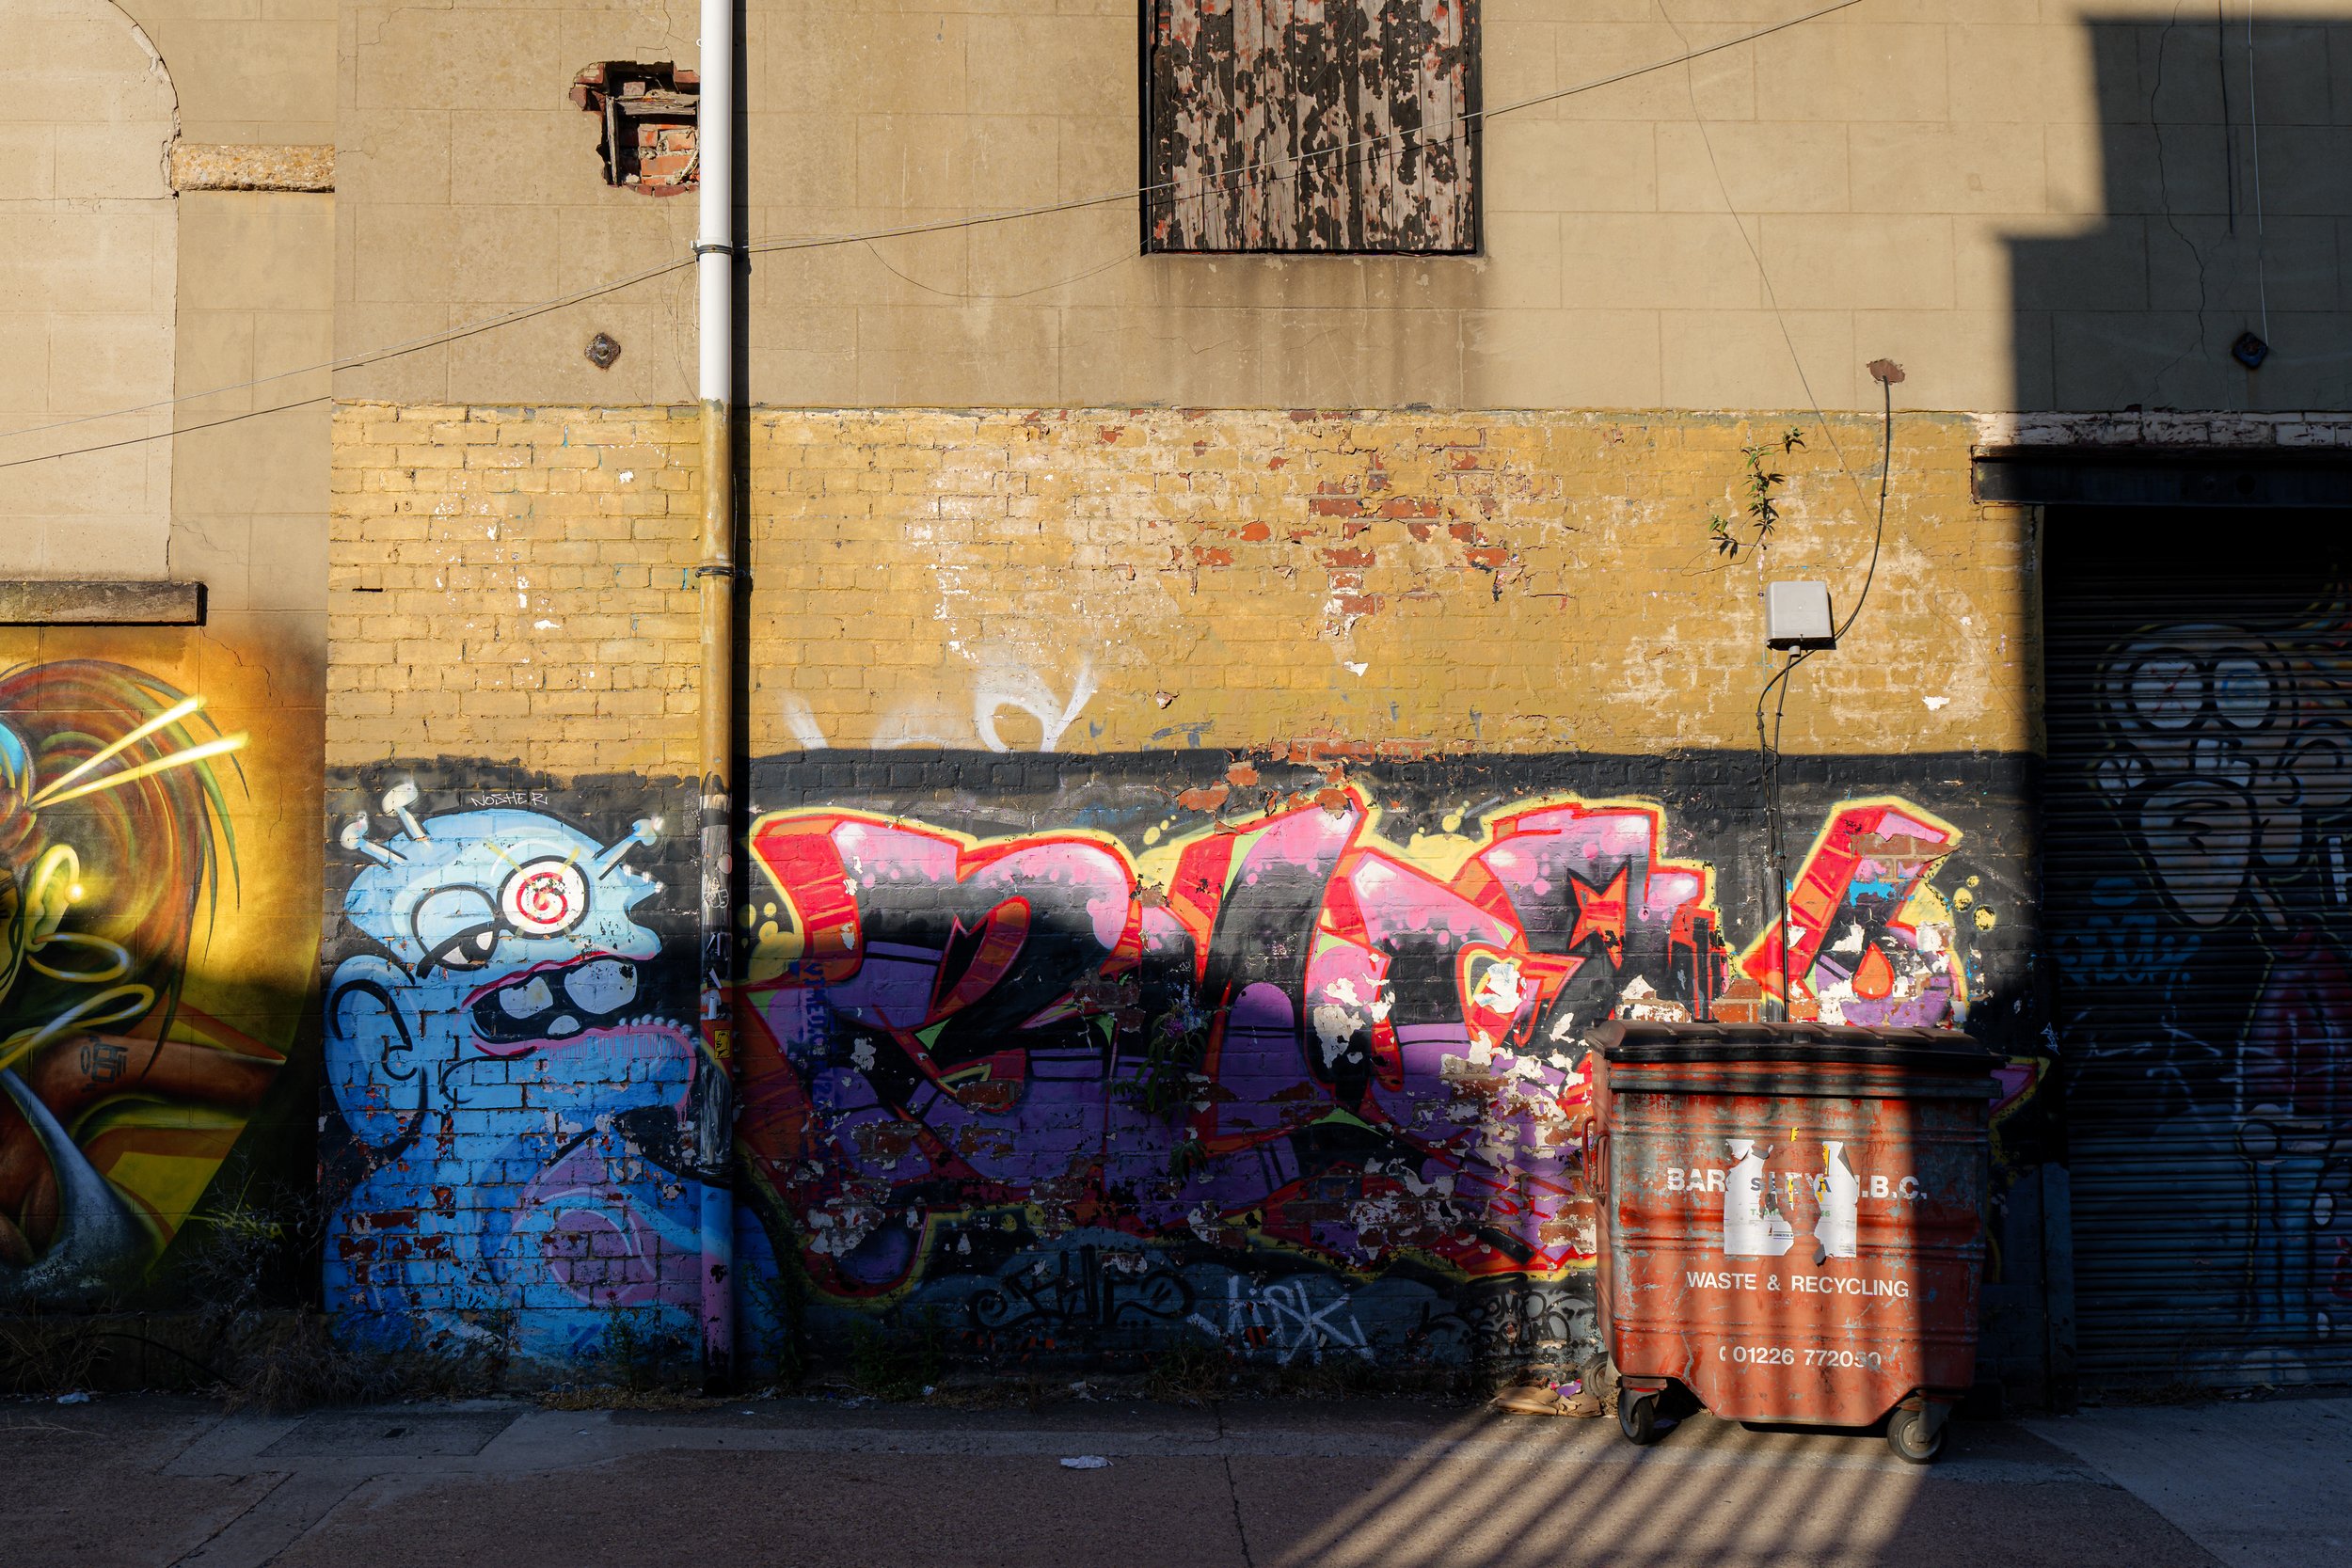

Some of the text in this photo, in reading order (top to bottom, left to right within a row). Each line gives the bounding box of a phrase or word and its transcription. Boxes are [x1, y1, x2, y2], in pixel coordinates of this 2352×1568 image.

[1686, 1271, 1909, 1298] WASTE & RECYCLING
[1732, 1345, 1795, 1366] 01226
